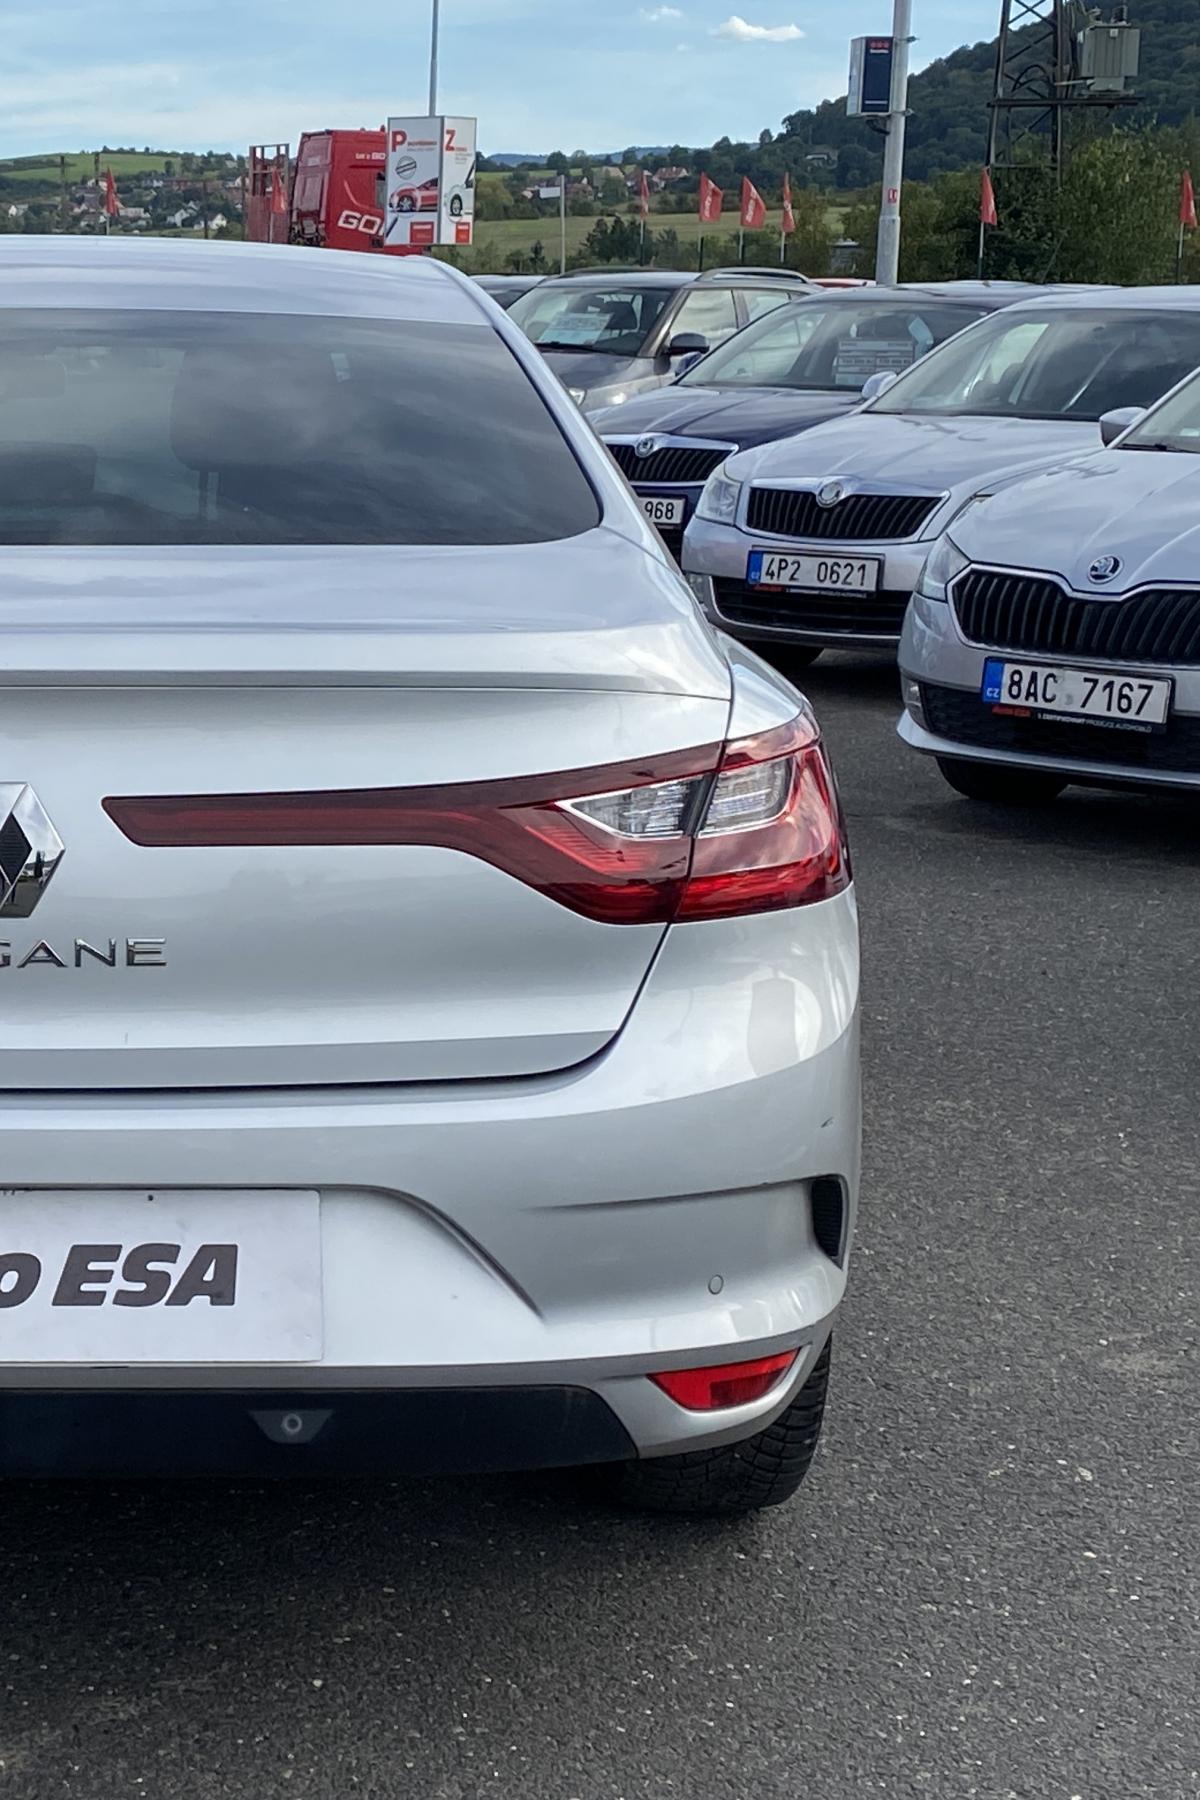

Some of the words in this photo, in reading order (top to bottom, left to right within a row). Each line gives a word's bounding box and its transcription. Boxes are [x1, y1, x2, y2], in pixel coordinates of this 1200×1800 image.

[337, 209, 385, 237] GO
[765, 557, 800, 581] 4P2
[816, 561, 867, 586] 0621
[986, 687, 999, 698] CZ
[1008, 669, 1058, 703] 8AC
[1080, 677, 1154, 716] 7167
[51, 1243, 239, 1308] ESA
